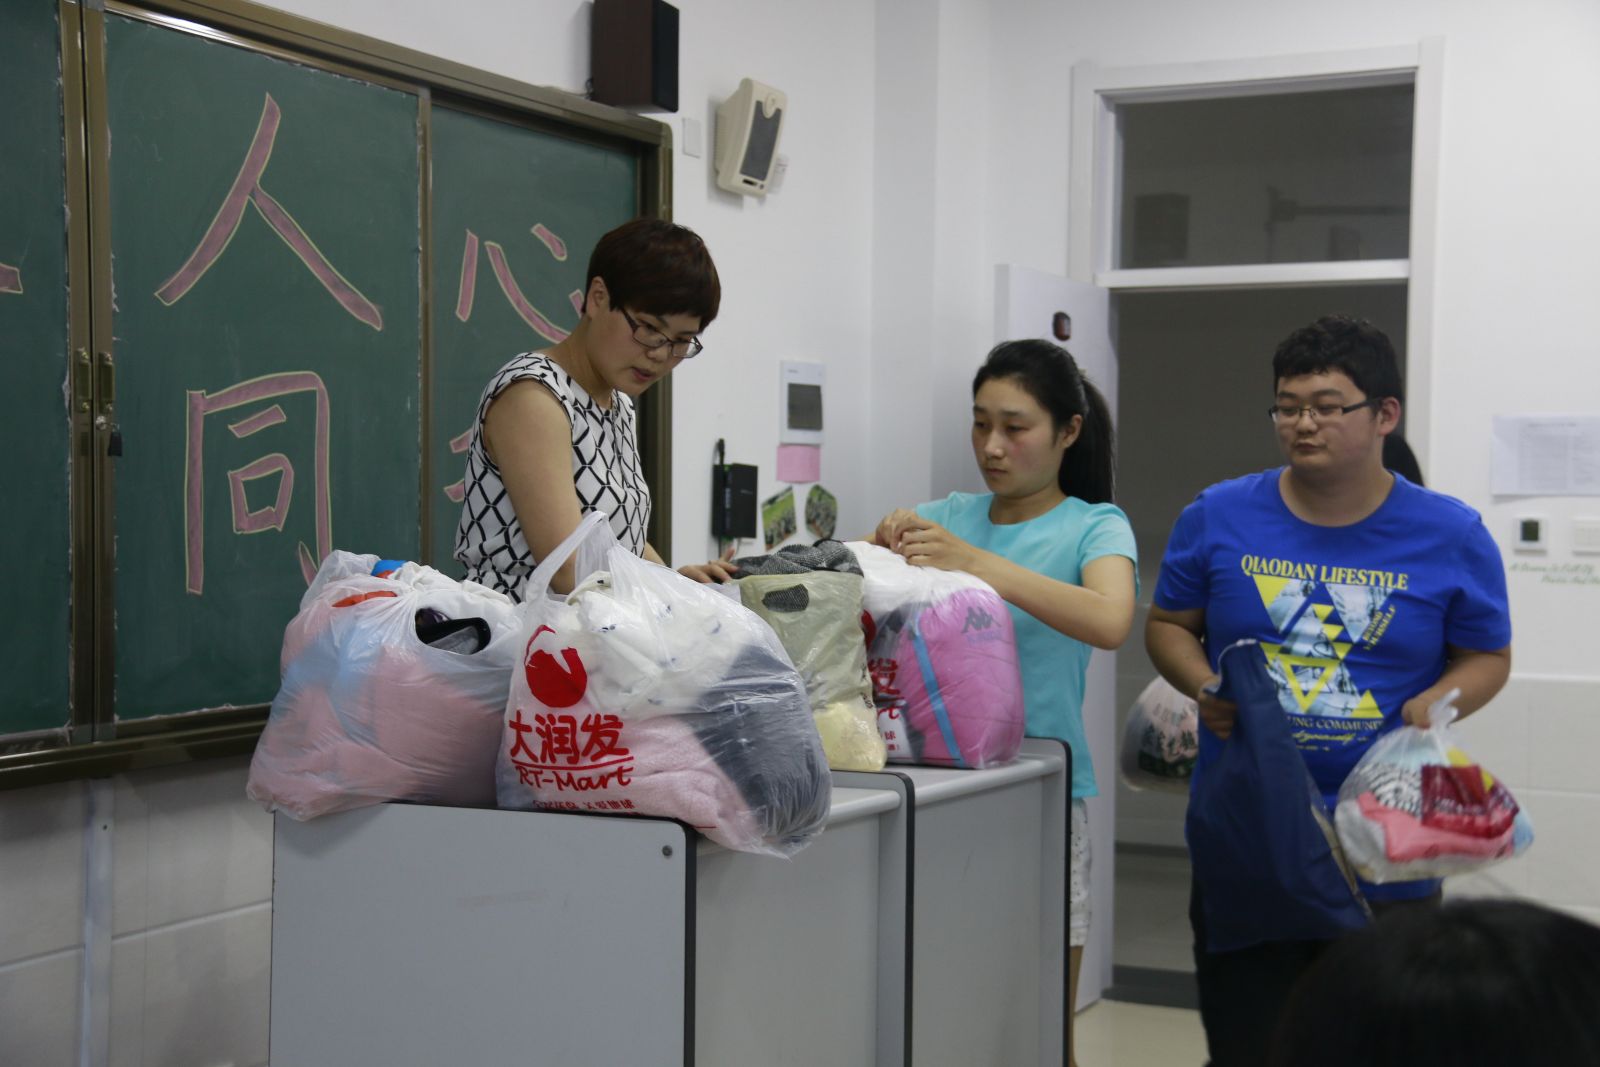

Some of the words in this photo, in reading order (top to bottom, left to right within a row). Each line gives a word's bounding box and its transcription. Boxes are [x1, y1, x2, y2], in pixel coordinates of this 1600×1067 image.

[154, 92, 384, 331] 人
[185, 370, 333, 595] 同
[1241, 554, 1317, 580] QIAODAN
[1319, 565, 1409, 591] LIFESTYLE
[508, 709, 630, 765] 大润发
[514, 765, 635, 792] RT-Mart
